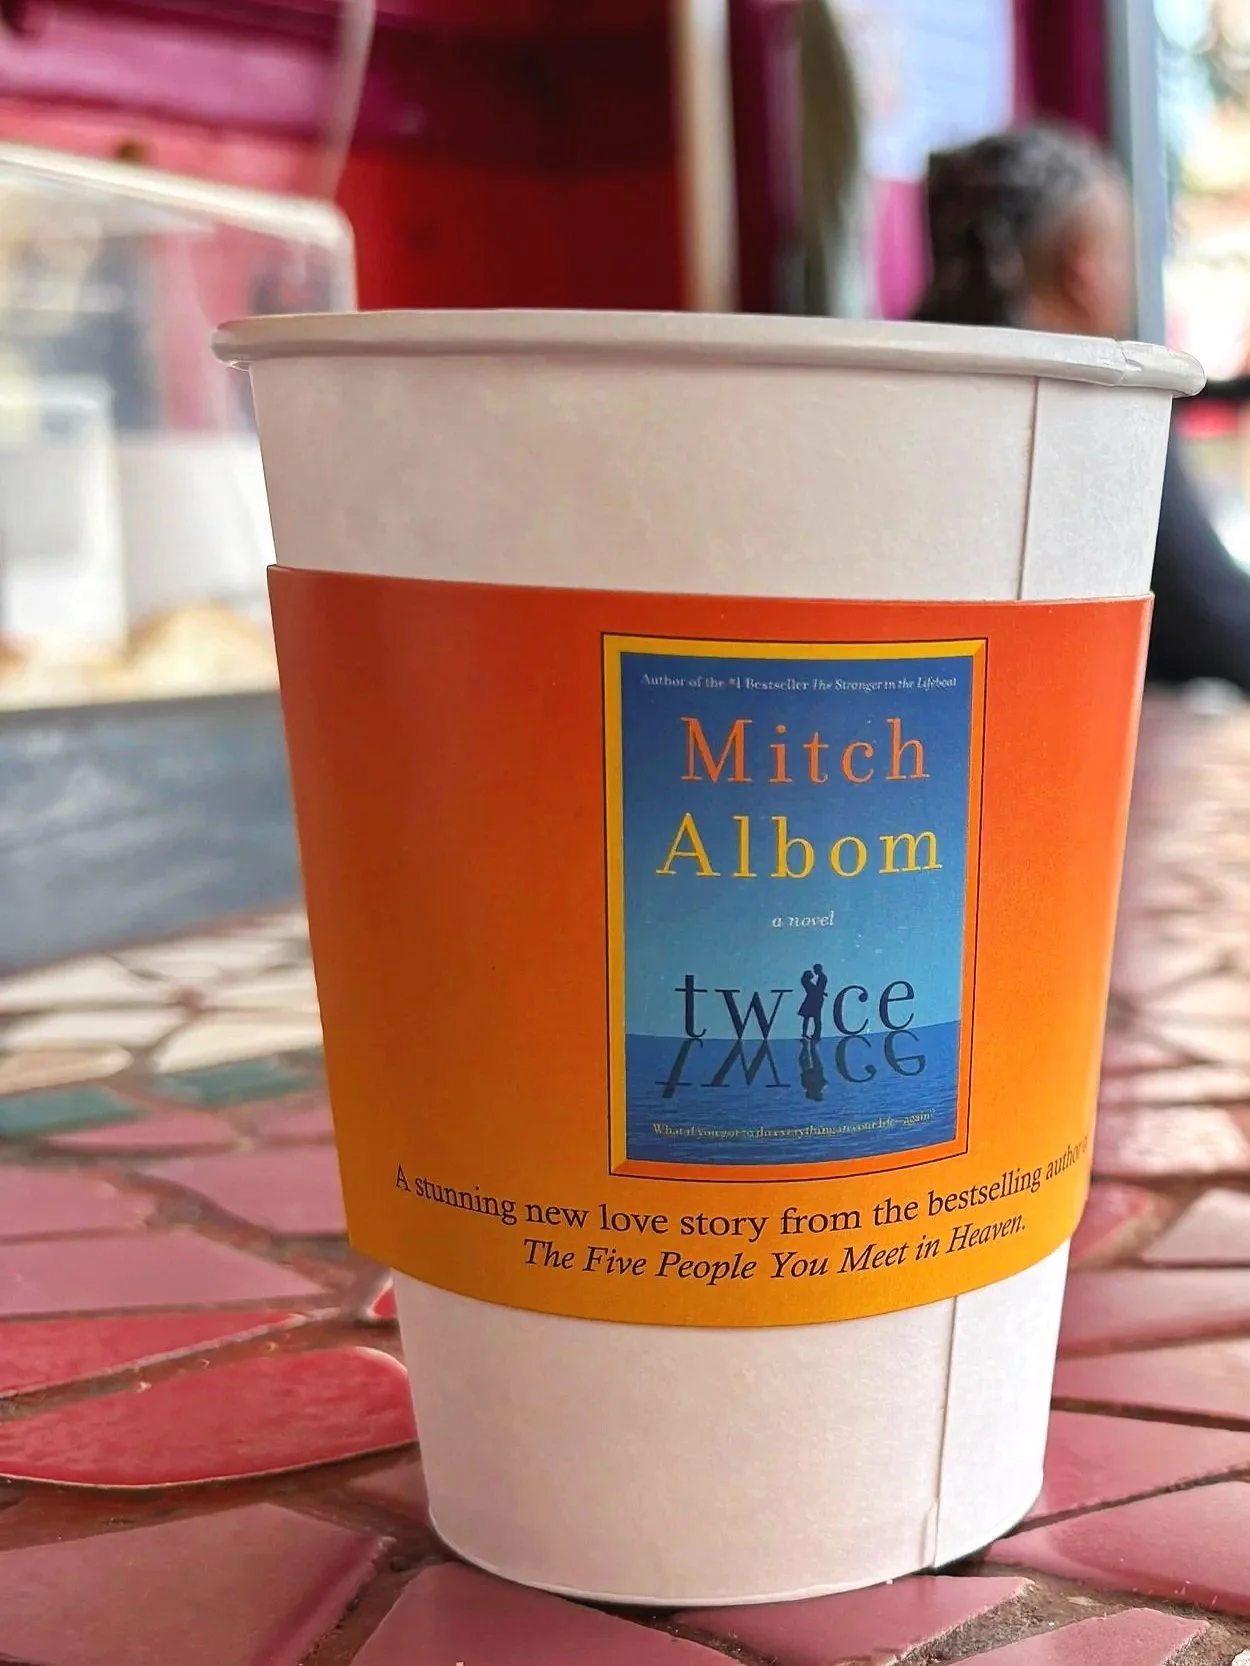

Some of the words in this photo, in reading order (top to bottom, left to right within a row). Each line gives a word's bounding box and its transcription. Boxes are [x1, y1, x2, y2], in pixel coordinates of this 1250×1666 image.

[640, 672, 686, 687] Author
[688, 675, 702, 688] of
[704, 675, 724, 689] the
[728, 676, 741, 689] #1
[745, 676, 809, 691] Bestseller
[812, 677, 832, 691] The
[834, 678, 884, 694] Stranger
[898, 677, 914, 690] the
[917, 676, 957, 692] Lifeboat
[680, 716, 931, 784] Mitch
[655, 811, 943, 879] Albom
[771, 914, 782, 928] a
[789, 910, 835, 928] novel
[652, 1122, 684, 1136] What
[396, 1163, 411, 1192] A
[415, 1176, 518, 1226] stunning
[524, 1203, 590, 1229] new
[599, 1203, 669, 1235] love
[680, 1212, 770, 1243] story
[780, 1206, 862, 1236] from
[873, 1197, 918, 1227] the
[927, 1167, 1042, 1217] bestselling
[1045, 1142, 1081, 1181] author
[524, 1238, 575, 1270] The
[582, 1245, 647, 1276] Five
[655, 1251, 757, 1287] People
[770, 1251, 830, 1279] You
[837, 1241, 910, 1275] Meet
[915, 1234, 940, 1261] in
[945, 1214, 1026, 1254] Heaven.
